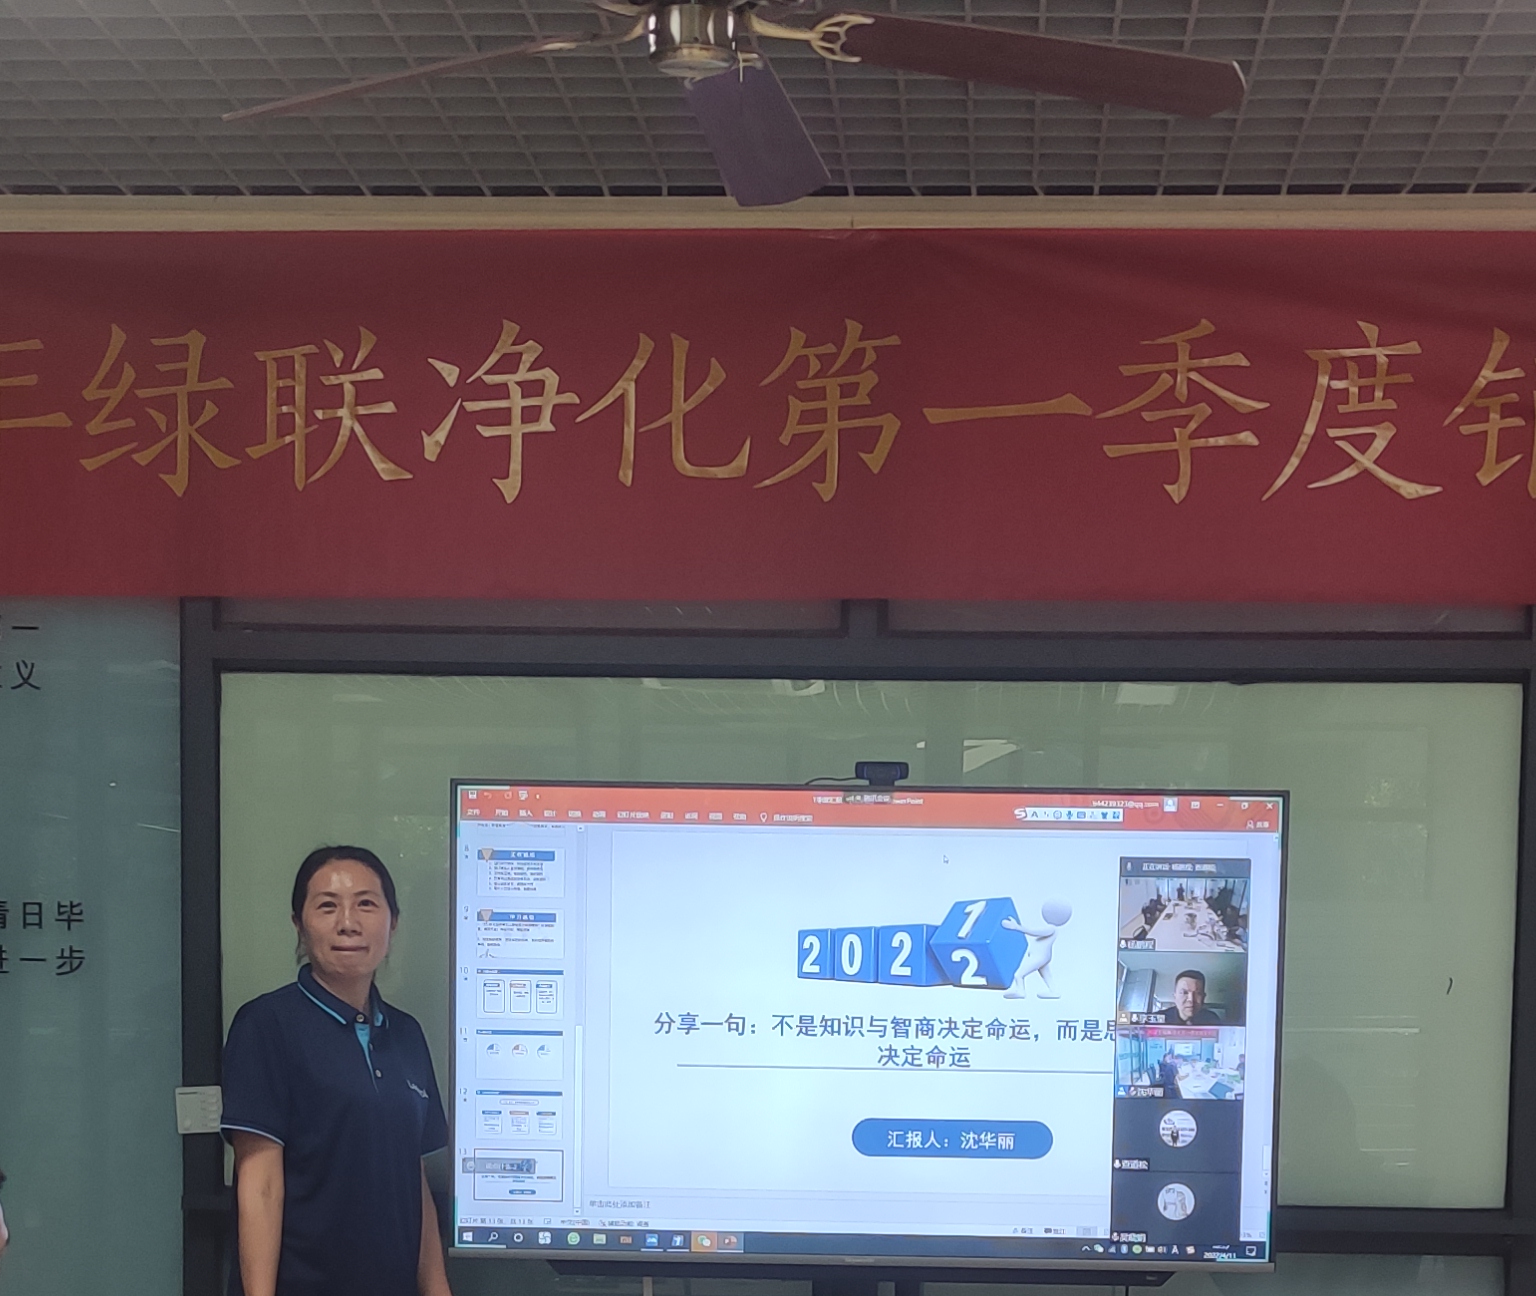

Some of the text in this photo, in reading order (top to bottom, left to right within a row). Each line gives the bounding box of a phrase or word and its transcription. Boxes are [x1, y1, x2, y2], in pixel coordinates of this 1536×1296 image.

[877, 1044, 971, 1069] 决定命运
[887, 1130, 1016, 1150] 汇报人：沈华丽
